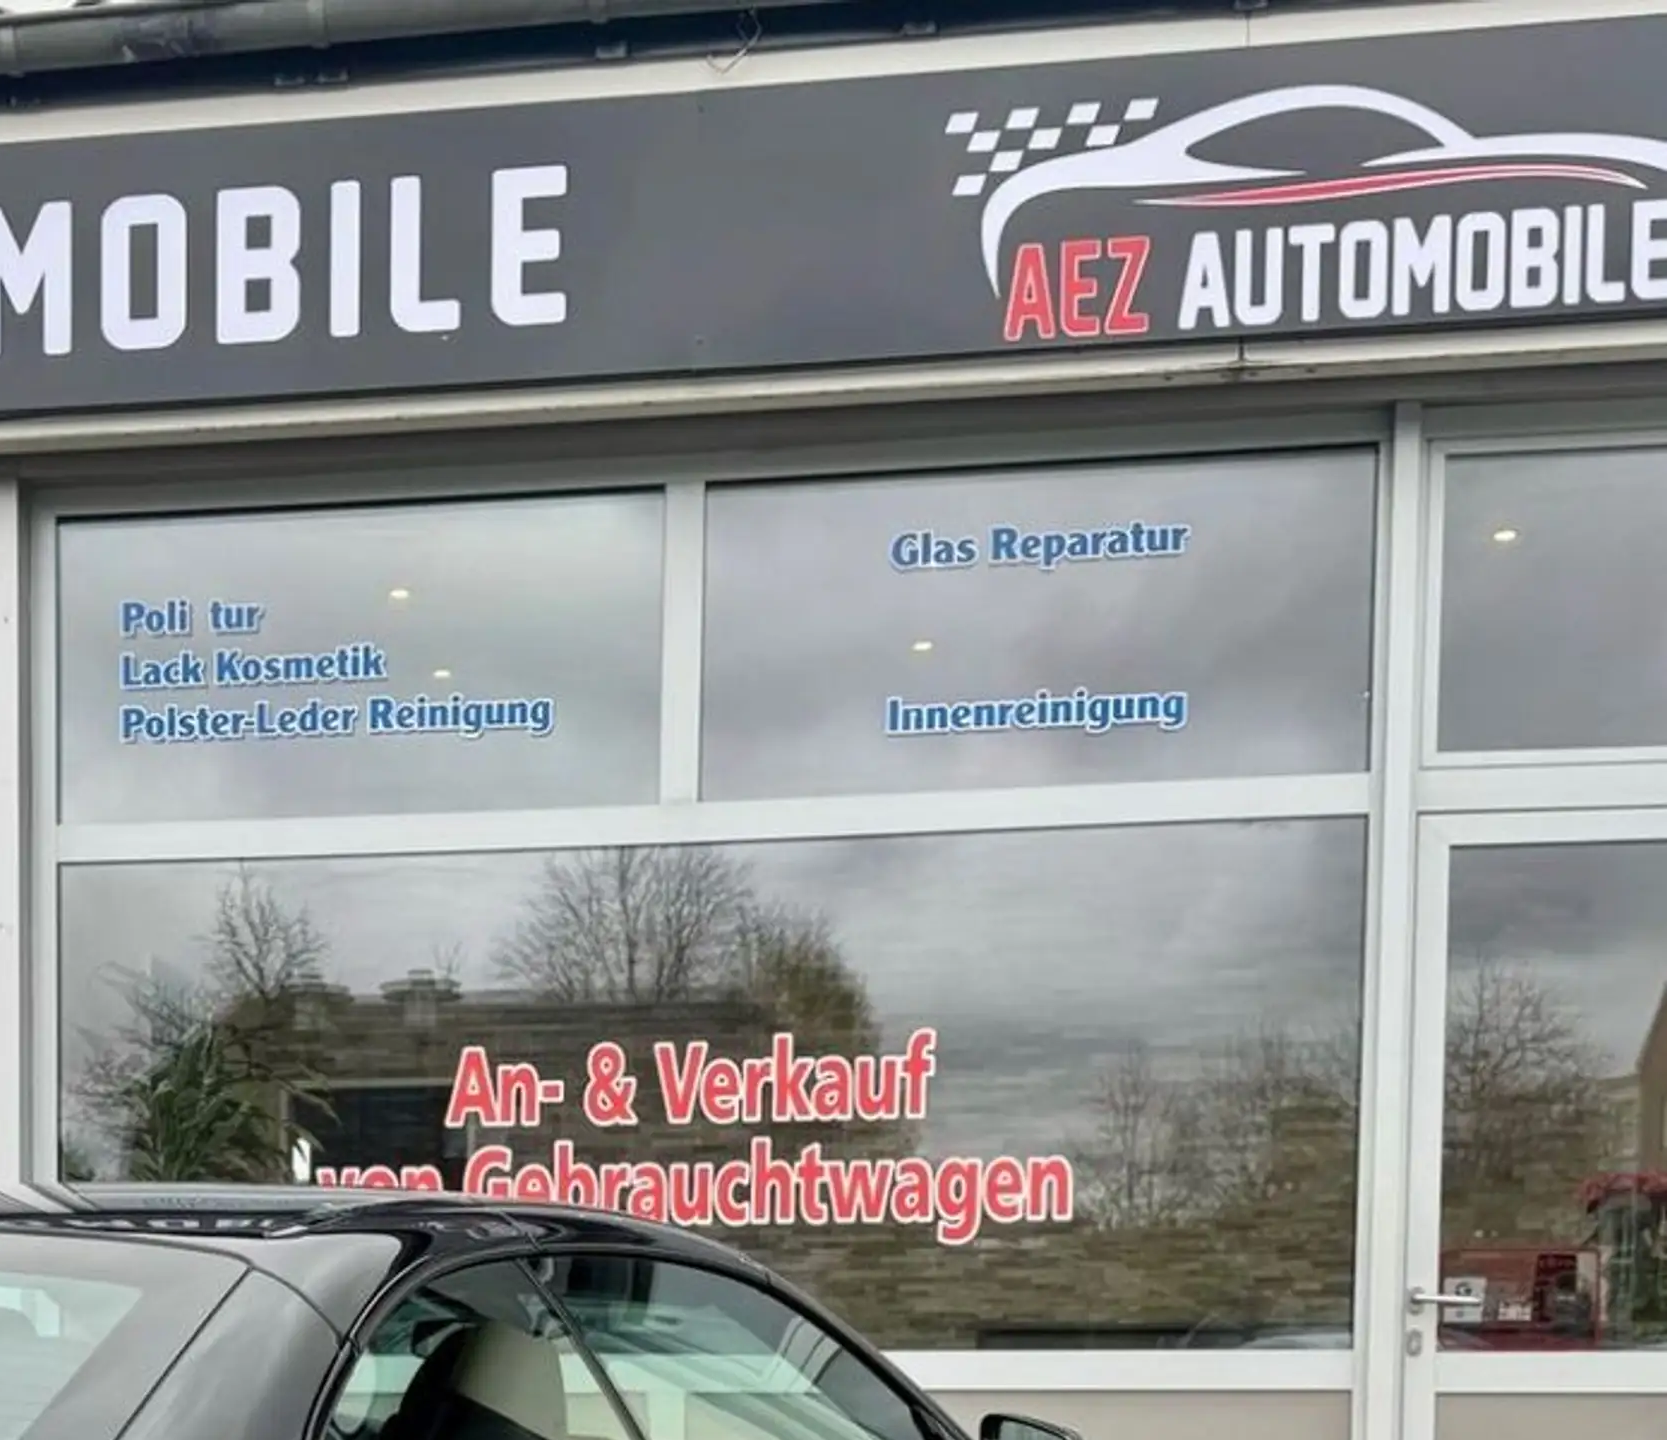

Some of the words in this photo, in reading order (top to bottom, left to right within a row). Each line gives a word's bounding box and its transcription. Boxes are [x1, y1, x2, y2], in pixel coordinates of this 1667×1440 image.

[1003, 235, 1151, 342] AEZ
[1178, 199, 1667, 330] AUTOMOBILE
[891, 530, 977, 568] Glas
[990, 520, 1191, 570] Reparatur
[120, 599, 192, 637] Poli
[210, 600, 263, 634] tur
[120, 652, 205, 689] Lack
[214, 643, 386, 685] Kosmetik
[120, 701, 357, 742] Polster-Leder
[369, 695, 552, 740] Reinigung
[886, 688, 1188, 735] Innenreinigung
[445, 1045, 564, 1128] An-
[583, 1040, 638, 1126] &
[654, 1026, 937, 1125] Verkauf
[462, 1136, 1075, 1245] Gebrauchtwagen
